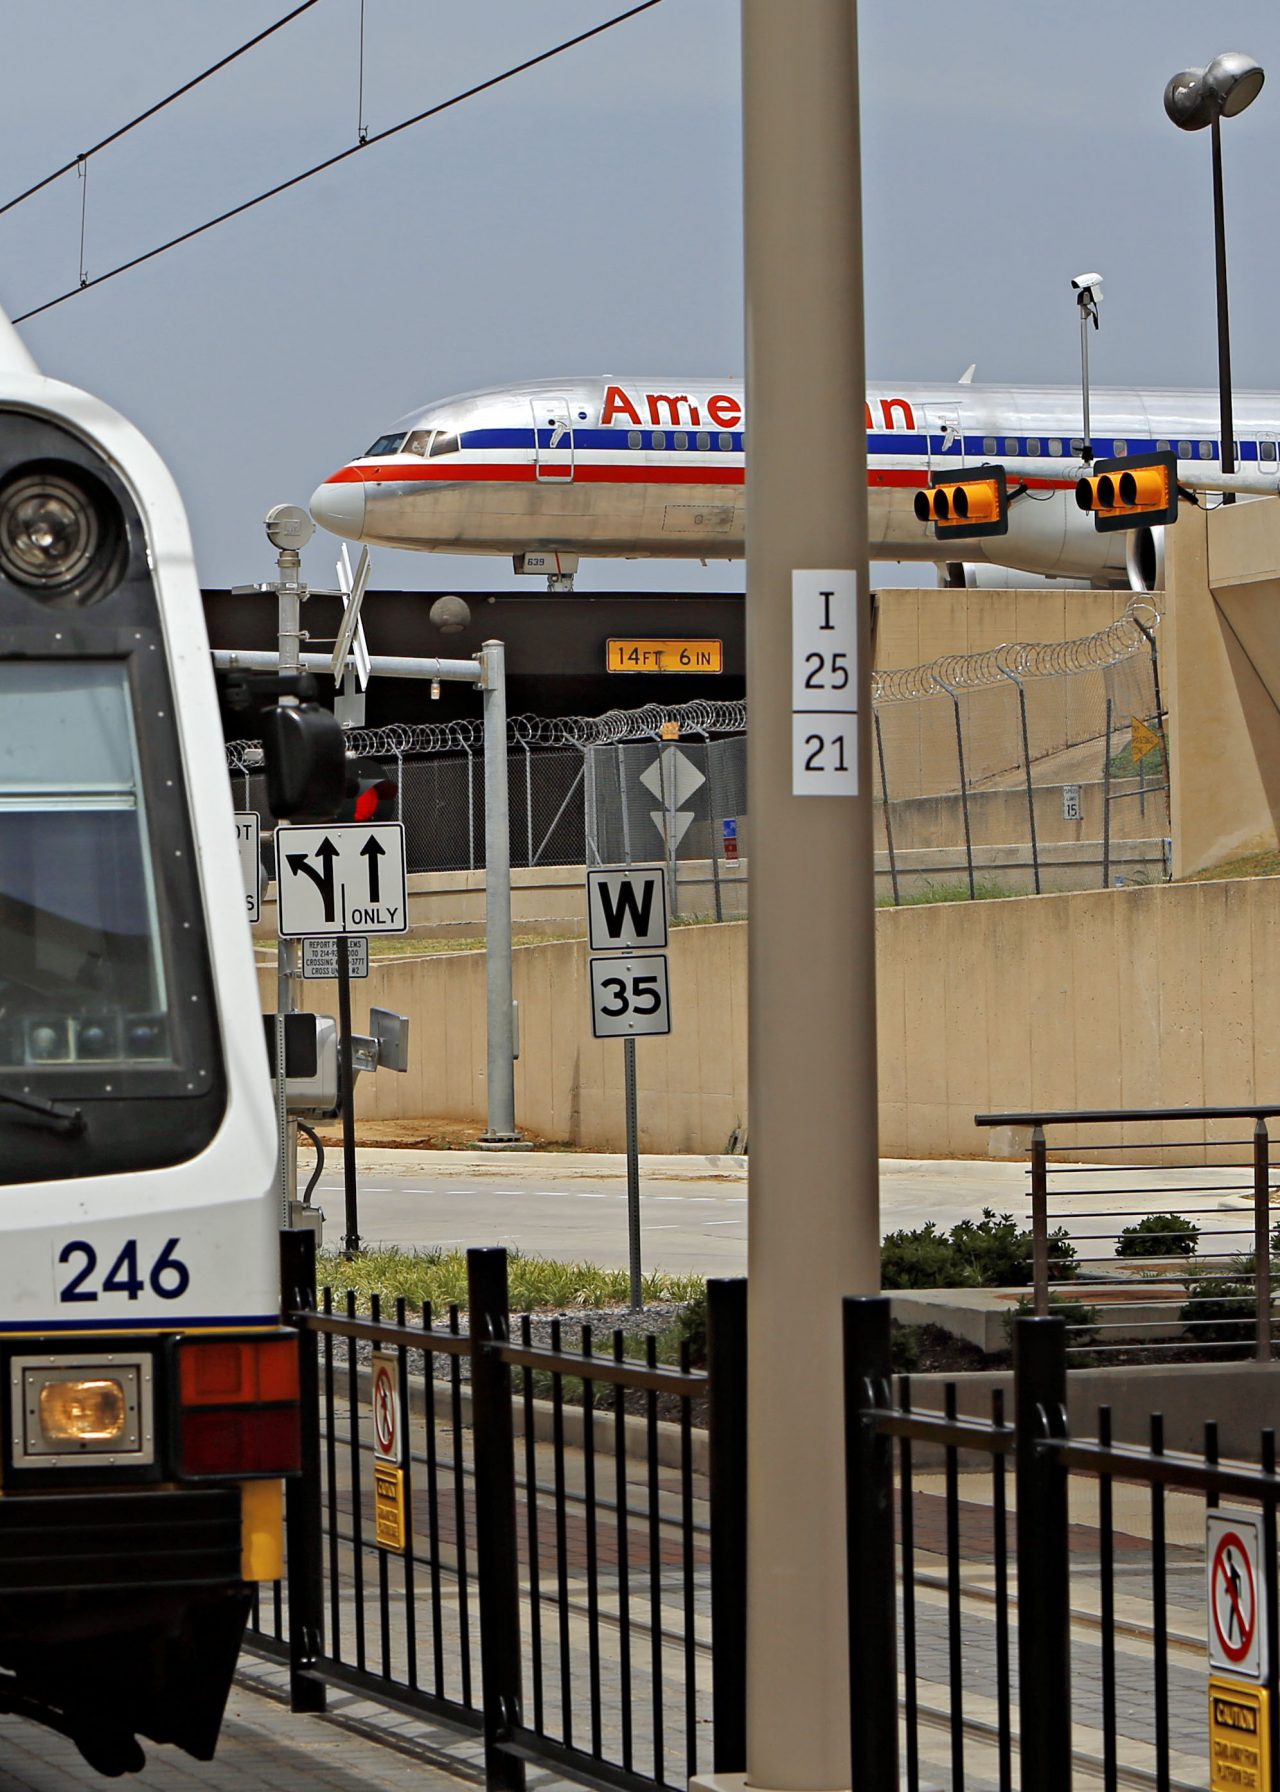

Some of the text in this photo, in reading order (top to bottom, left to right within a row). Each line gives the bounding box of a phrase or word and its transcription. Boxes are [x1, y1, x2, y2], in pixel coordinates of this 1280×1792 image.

[600, 385, 917, 431] Amen
[527, 557, 545, 566] 639
[804, 652, 850, 690] 25
[804, 733, 849, 772] 21
[1067, 803, 1078, 817] 15
[351, 907, 399, 925] ONLY
[597, 880, 655, 939] W
[308, 940, 362, 949] REPORT PLEMS
[311, 949, 319, 958] TO
[305, 958, 334, 967] CROSSING
[311, 967, 330, 976] CROSS
[600, 975, 662, 1018] 35
[58, 1237, 190, 1303] 246
